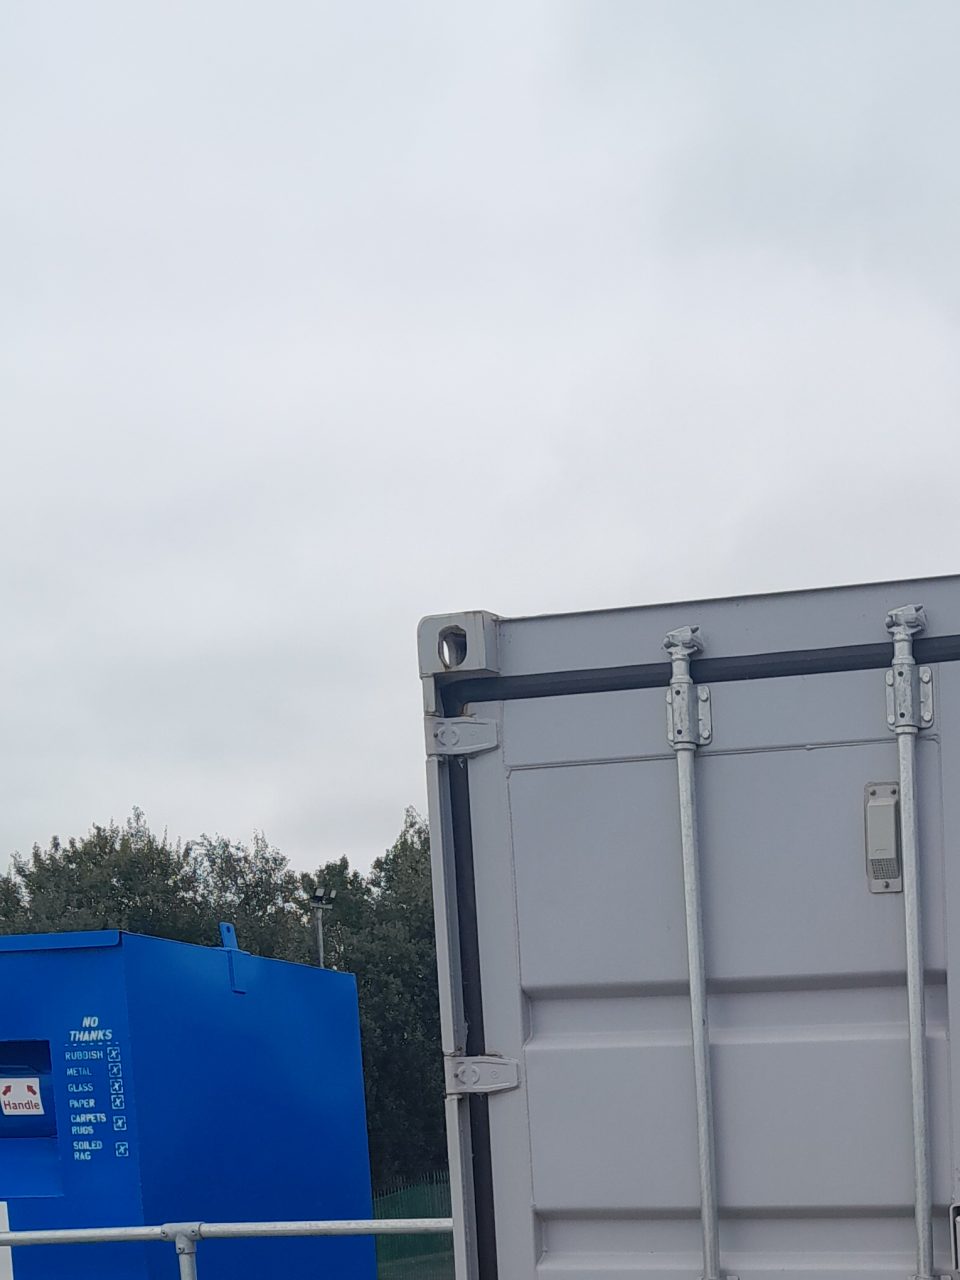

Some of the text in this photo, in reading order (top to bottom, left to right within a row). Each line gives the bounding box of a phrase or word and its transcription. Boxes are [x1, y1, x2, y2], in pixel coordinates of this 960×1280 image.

[82, 1016, 98, 1027] NO
[69, 1030, 112, 1041] THANKS
[67, 1067, 92, 1076] METAL
[68, 1083, 93, 1092] GLASS
[4, 1100, 41, 1110] Handle
[69, 1099, 95, 1108] PAPER
[71, 1113, 106, 1123] CARPETS
[72, 1126, 94, 1135] RUGS
[73, 1141, 103, 1150] SOILED
[74, 1152, 91, 1160] RAG
